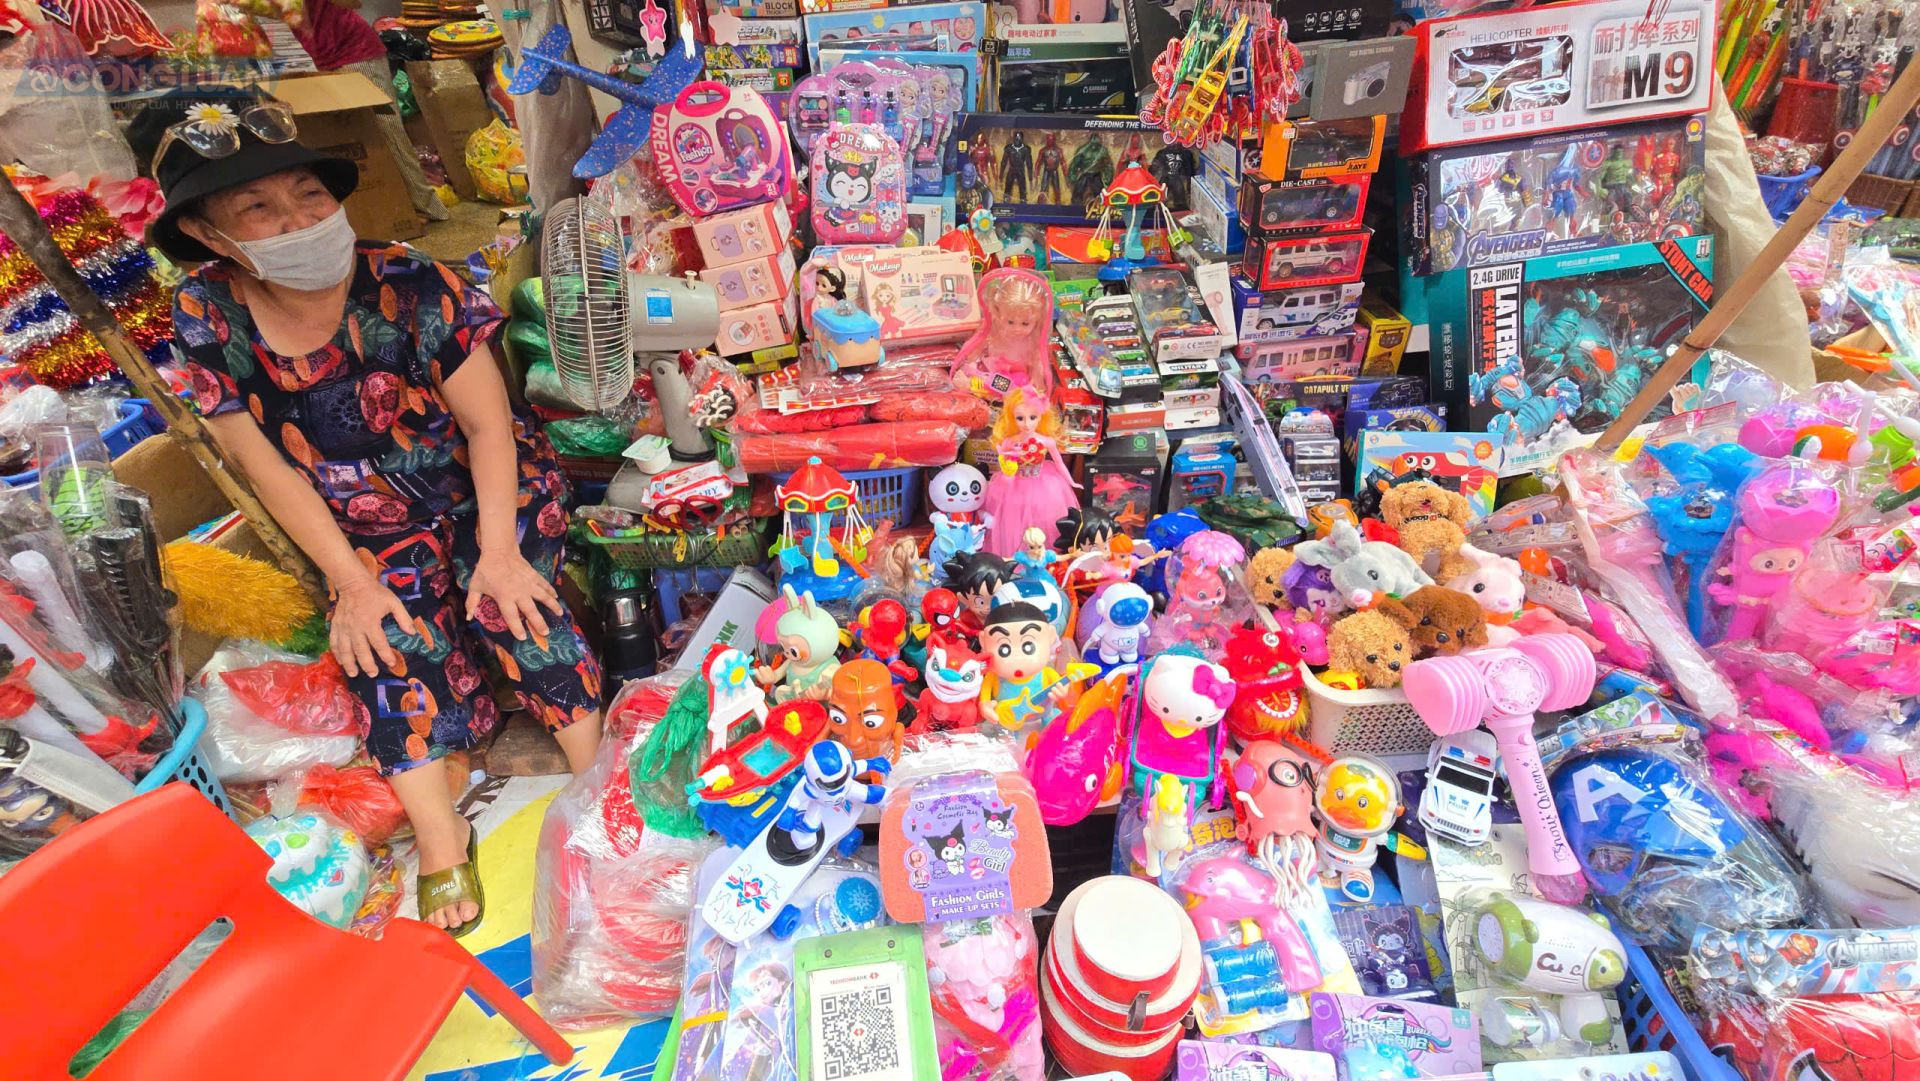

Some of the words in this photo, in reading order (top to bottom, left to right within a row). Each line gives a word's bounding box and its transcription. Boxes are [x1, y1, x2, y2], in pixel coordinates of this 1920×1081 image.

[765, 1, 793, 10] BLOCK
[1470, 28, 1532, 44] HELICOPTER
[1623, 50, 1694, 99] M9
[1085, 121, 1124, 129] DEFENDING
[1125, 121, 1140, 129] THE
[653, 113, 679, 184] DREAM
[1281, 179, 1317, 188] DIE-CAST
[1473, 271, 1493, 286] 2.4G
[1495, 266, 1520, 283] DRIVE
[1660, 239, 1696, 280] STUNT
[1688, 271, 1713, 303] CAR
[1303, 385, 1339, 394] CATAPULT
[971, 839, 1009, 861] Beauty
[984, 857, 1006, 872] Girl
[981, 901, 1000, 910] SETS
[1826, 937, 1918, 969] AVENGERS
